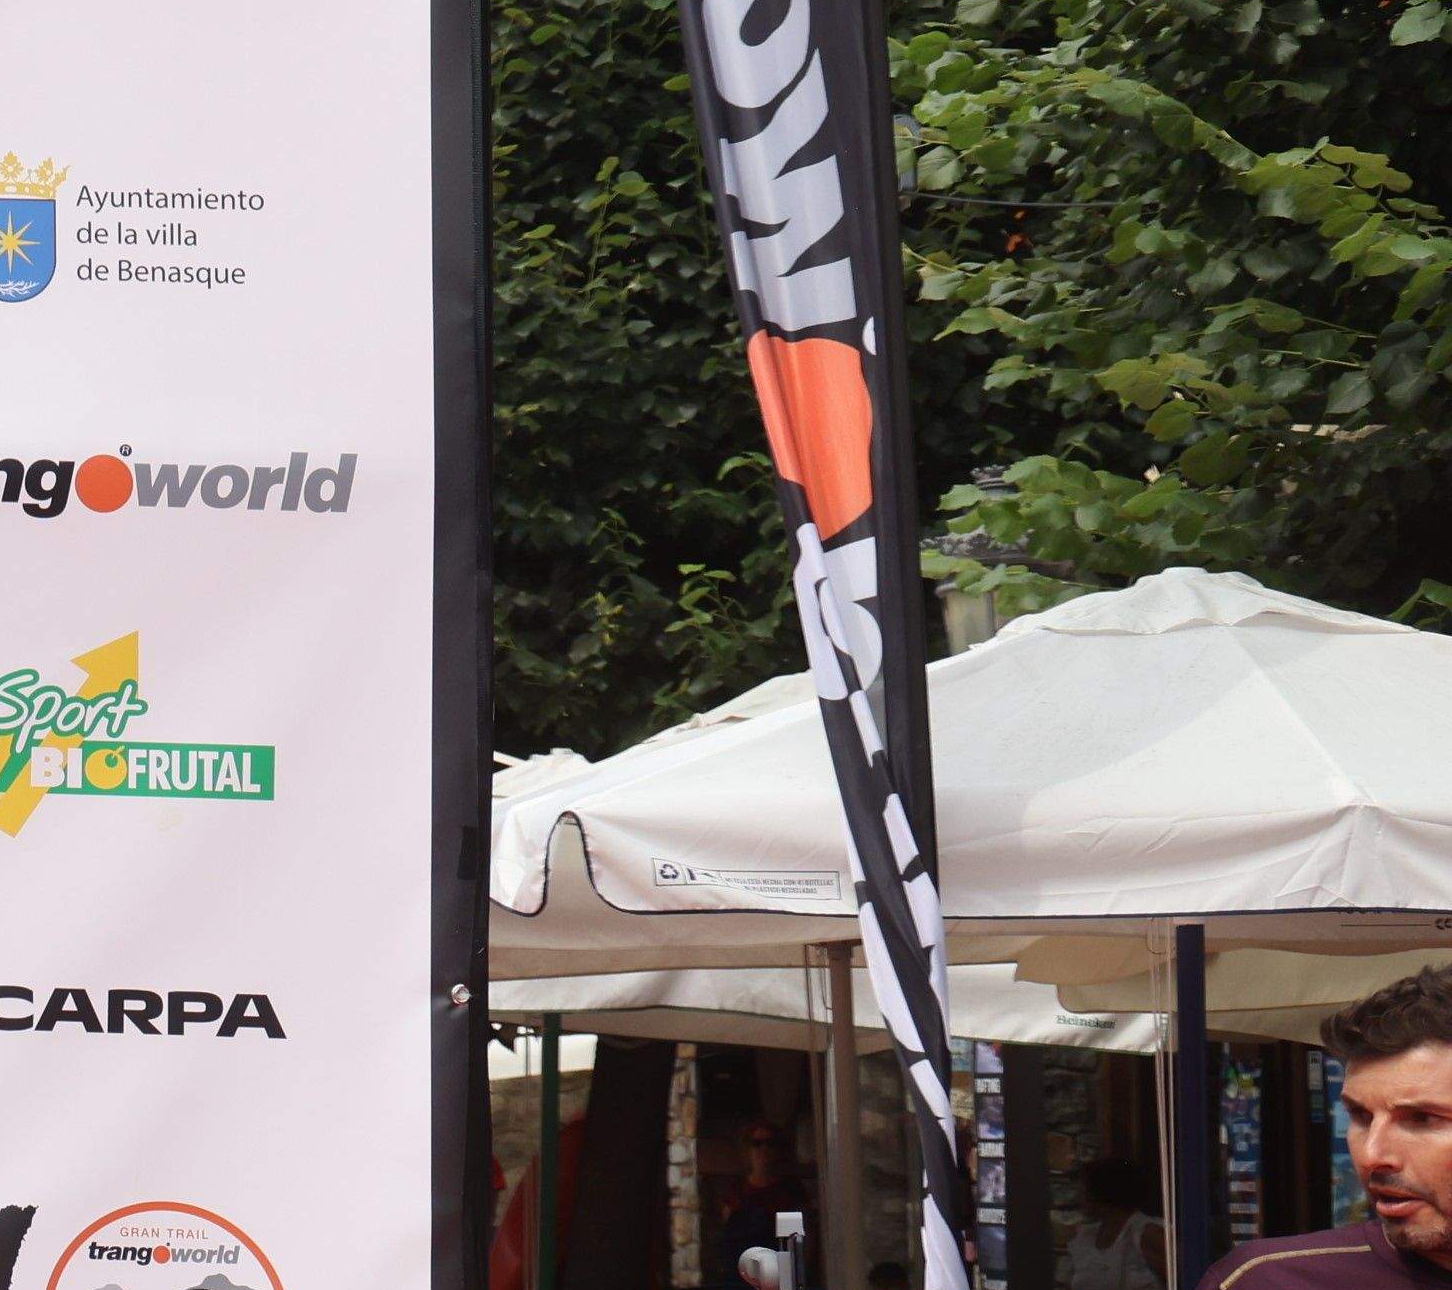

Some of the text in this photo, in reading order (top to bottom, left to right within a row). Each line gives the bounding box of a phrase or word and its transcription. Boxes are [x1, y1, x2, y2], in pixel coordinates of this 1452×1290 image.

[76, 186, 265, 213] Ayuntamiento
[76, 223, 198, 247] de la villa
[76, 259, 246, 290] de Benasque
[120, 1227, 209, 1240] GRAN TRAIL
